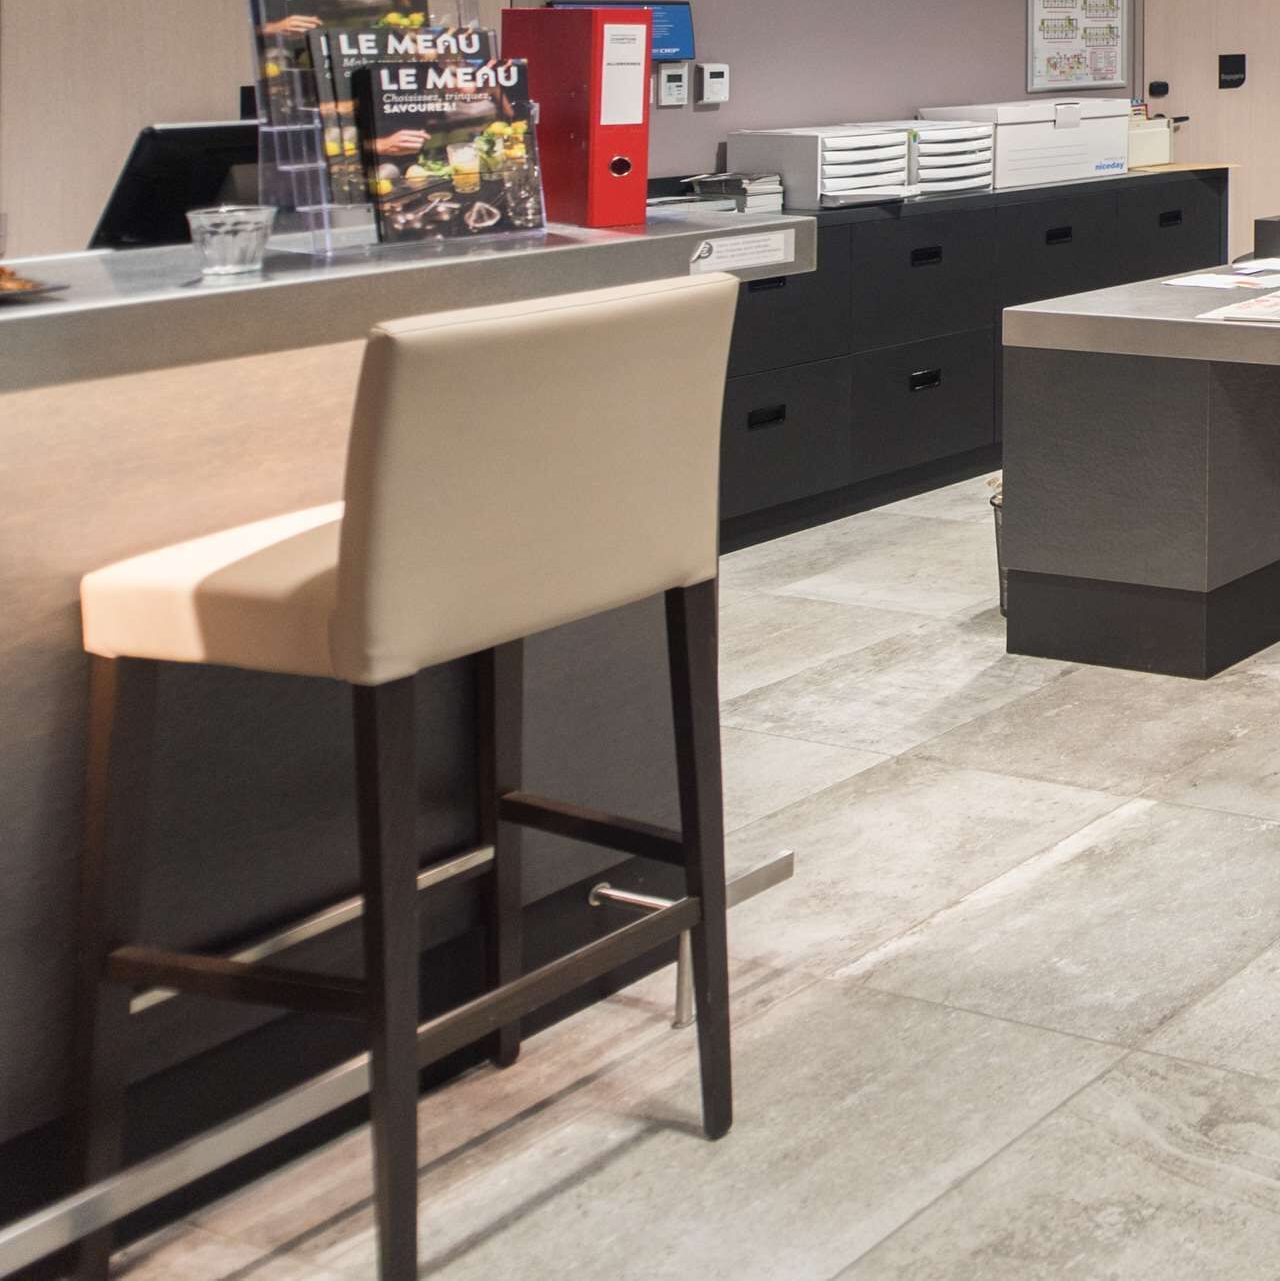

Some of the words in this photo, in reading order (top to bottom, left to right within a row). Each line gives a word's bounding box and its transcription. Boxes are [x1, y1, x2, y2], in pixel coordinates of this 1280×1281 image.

[338, 33, 378, 55] LE
[387, 33, 480, 55] MENU
[380, 68, 419, 91] LE
[426, 66, 518, 90] MENU
[382, 93, 442, 104] Choisissez,
[445, 91, 492, 103] trinquez,
[383, 103, 457, 114] SAVOUREZ!
[1095, 159, 1124, 170] niceday
